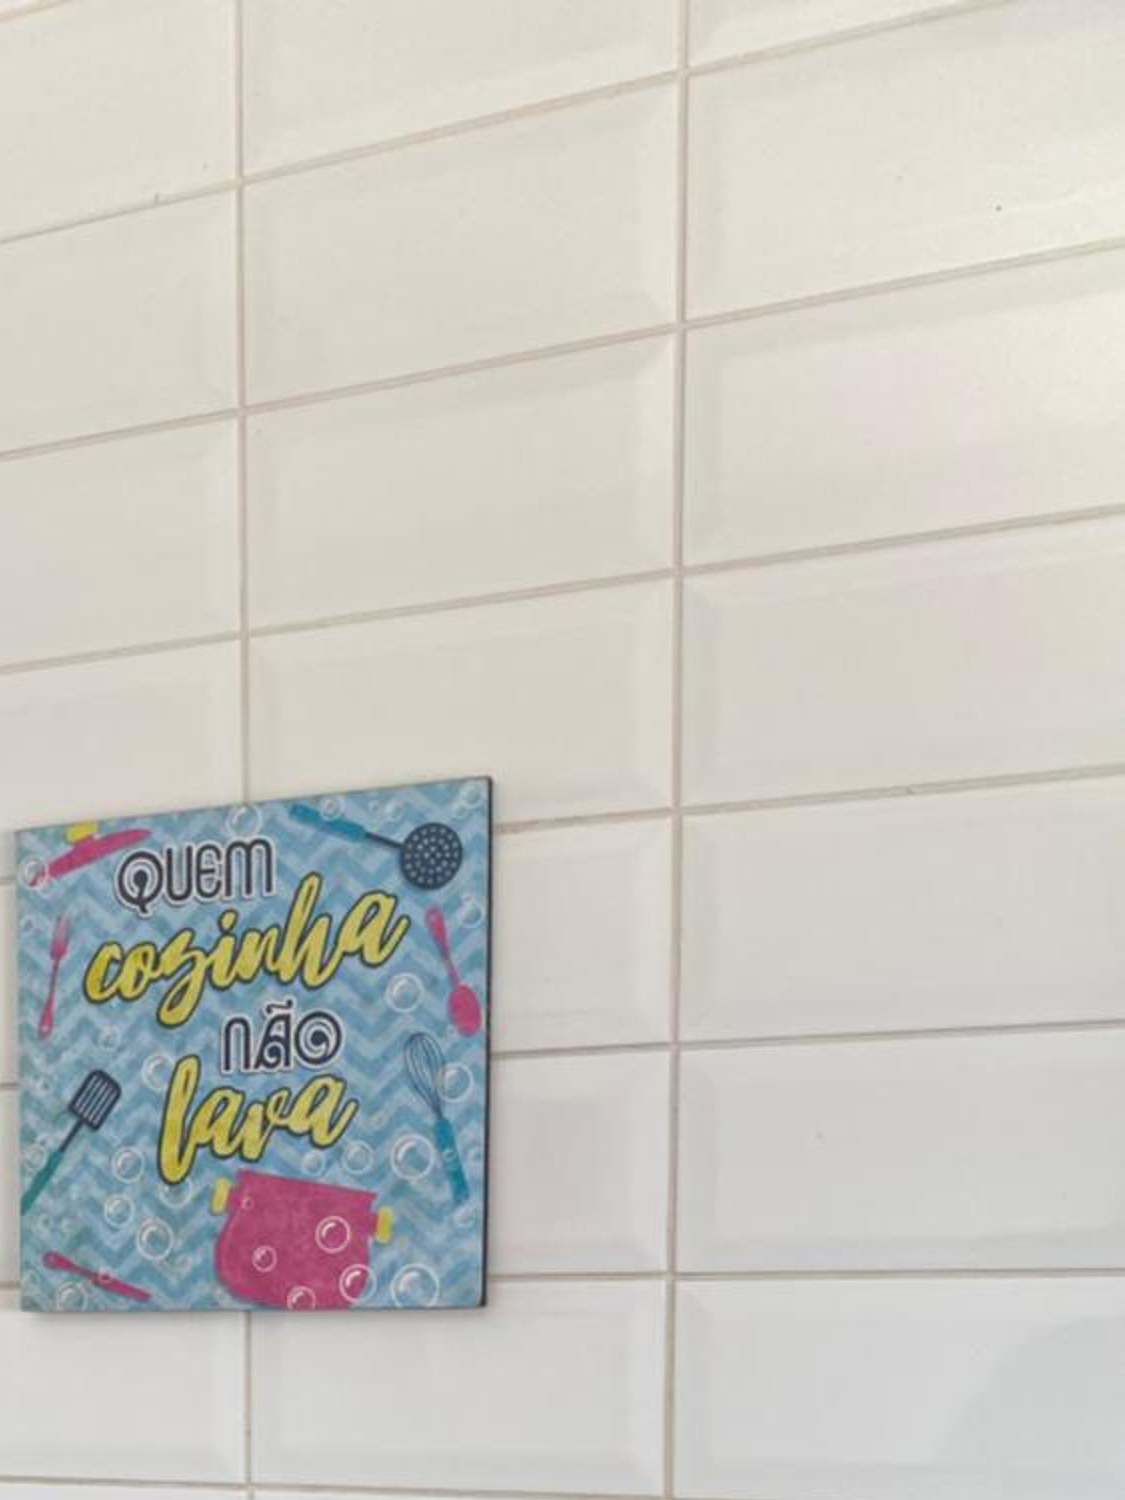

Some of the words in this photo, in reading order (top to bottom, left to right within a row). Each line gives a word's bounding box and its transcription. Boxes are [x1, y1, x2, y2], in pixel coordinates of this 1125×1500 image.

[117, 837, 274, 914] QUEM
[83, 871, 411, 1028] cozinha
[221, 999, 343, 1074] NÃO
[158, 1054, 359, 1185] lava
